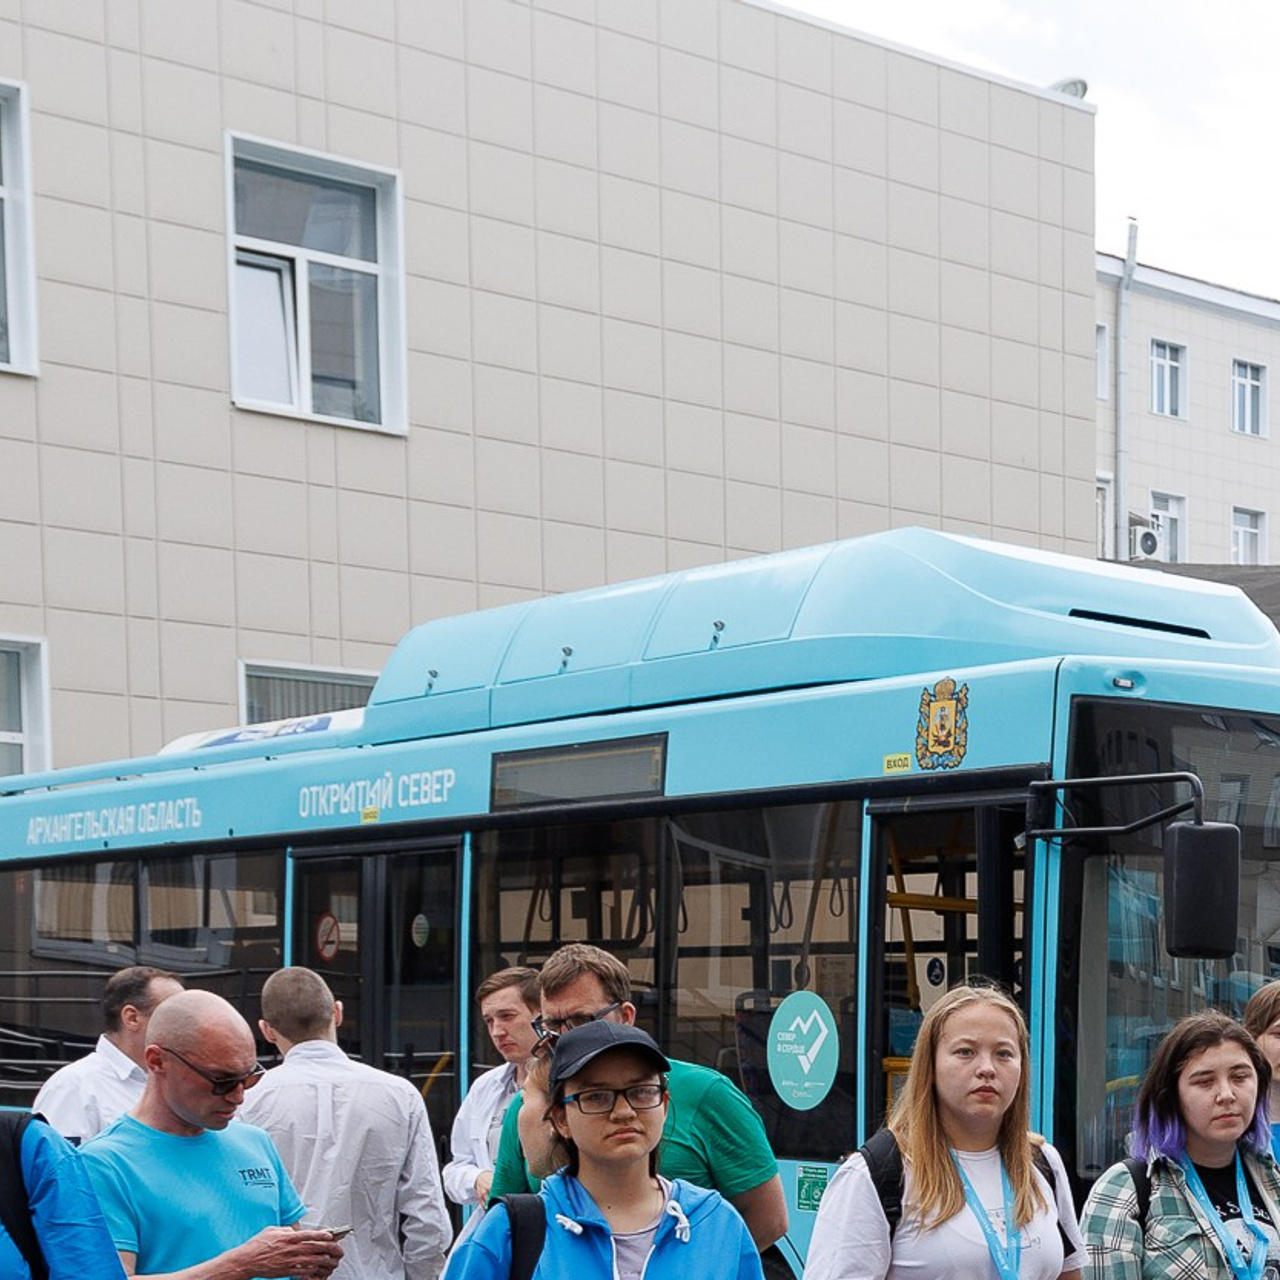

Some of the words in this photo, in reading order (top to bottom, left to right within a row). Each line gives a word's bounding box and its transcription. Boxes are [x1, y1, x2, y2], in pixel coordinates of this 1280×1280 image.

[886, 757, 909, 769] ВХОД
[299, 771, 394, 817] ОТКРЫТЫЙ
[397, 768, 456, 808] СЕВЕР
[27, 807, 136, 844] АРХАНГЕЛЬСКАЯ
[138, 797, 202, 833] ОБЛАСТЬ
[238, 1167, 271, 1181] TRMT
